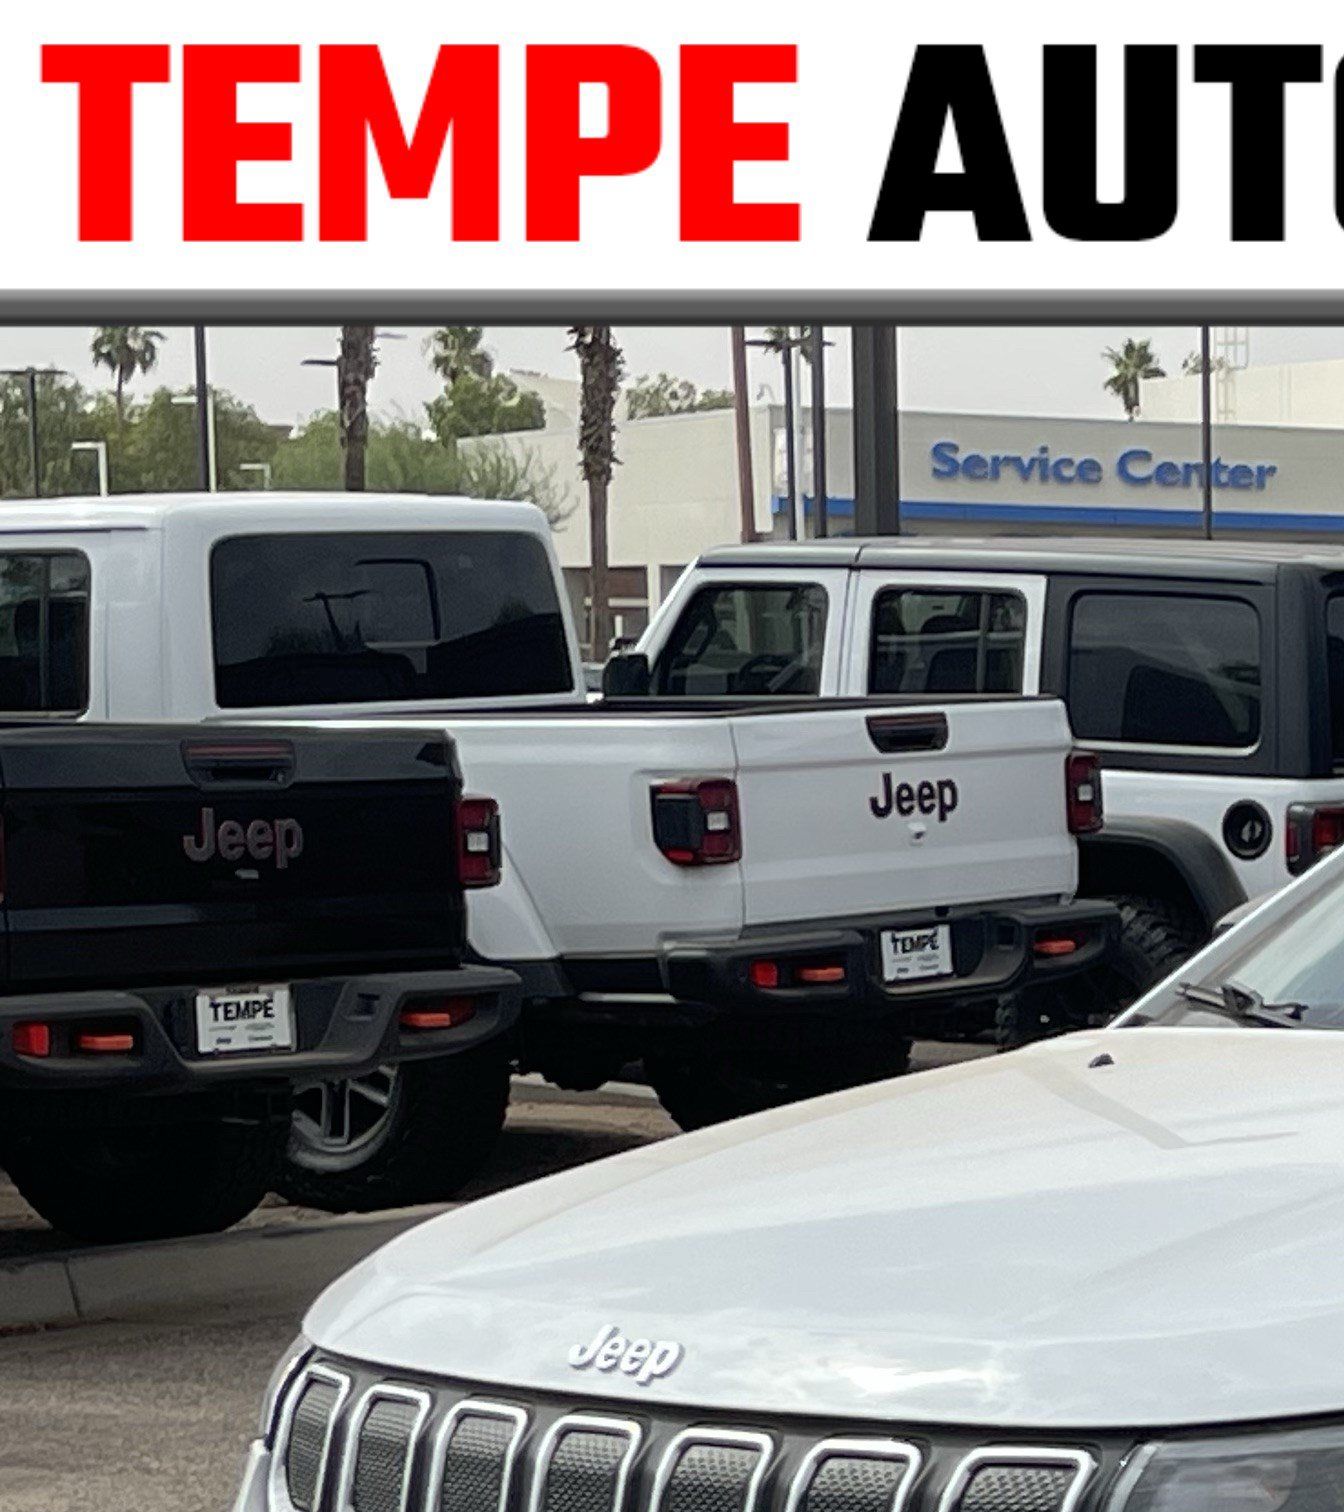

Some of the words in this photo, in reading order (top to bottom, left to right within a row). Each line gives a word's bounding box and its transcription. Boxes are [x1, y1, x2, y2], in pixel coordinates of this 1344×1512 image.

[931, 441, 1102, 484] Service
[1117, 449, 1278, 490] Center
[868, 772, 958, 823] Jeep
[183, 807, 303, 869] Jeep
[209, 999, 275, 1022] TEMPE
[569, 1324, 686, 1386] Jeep
